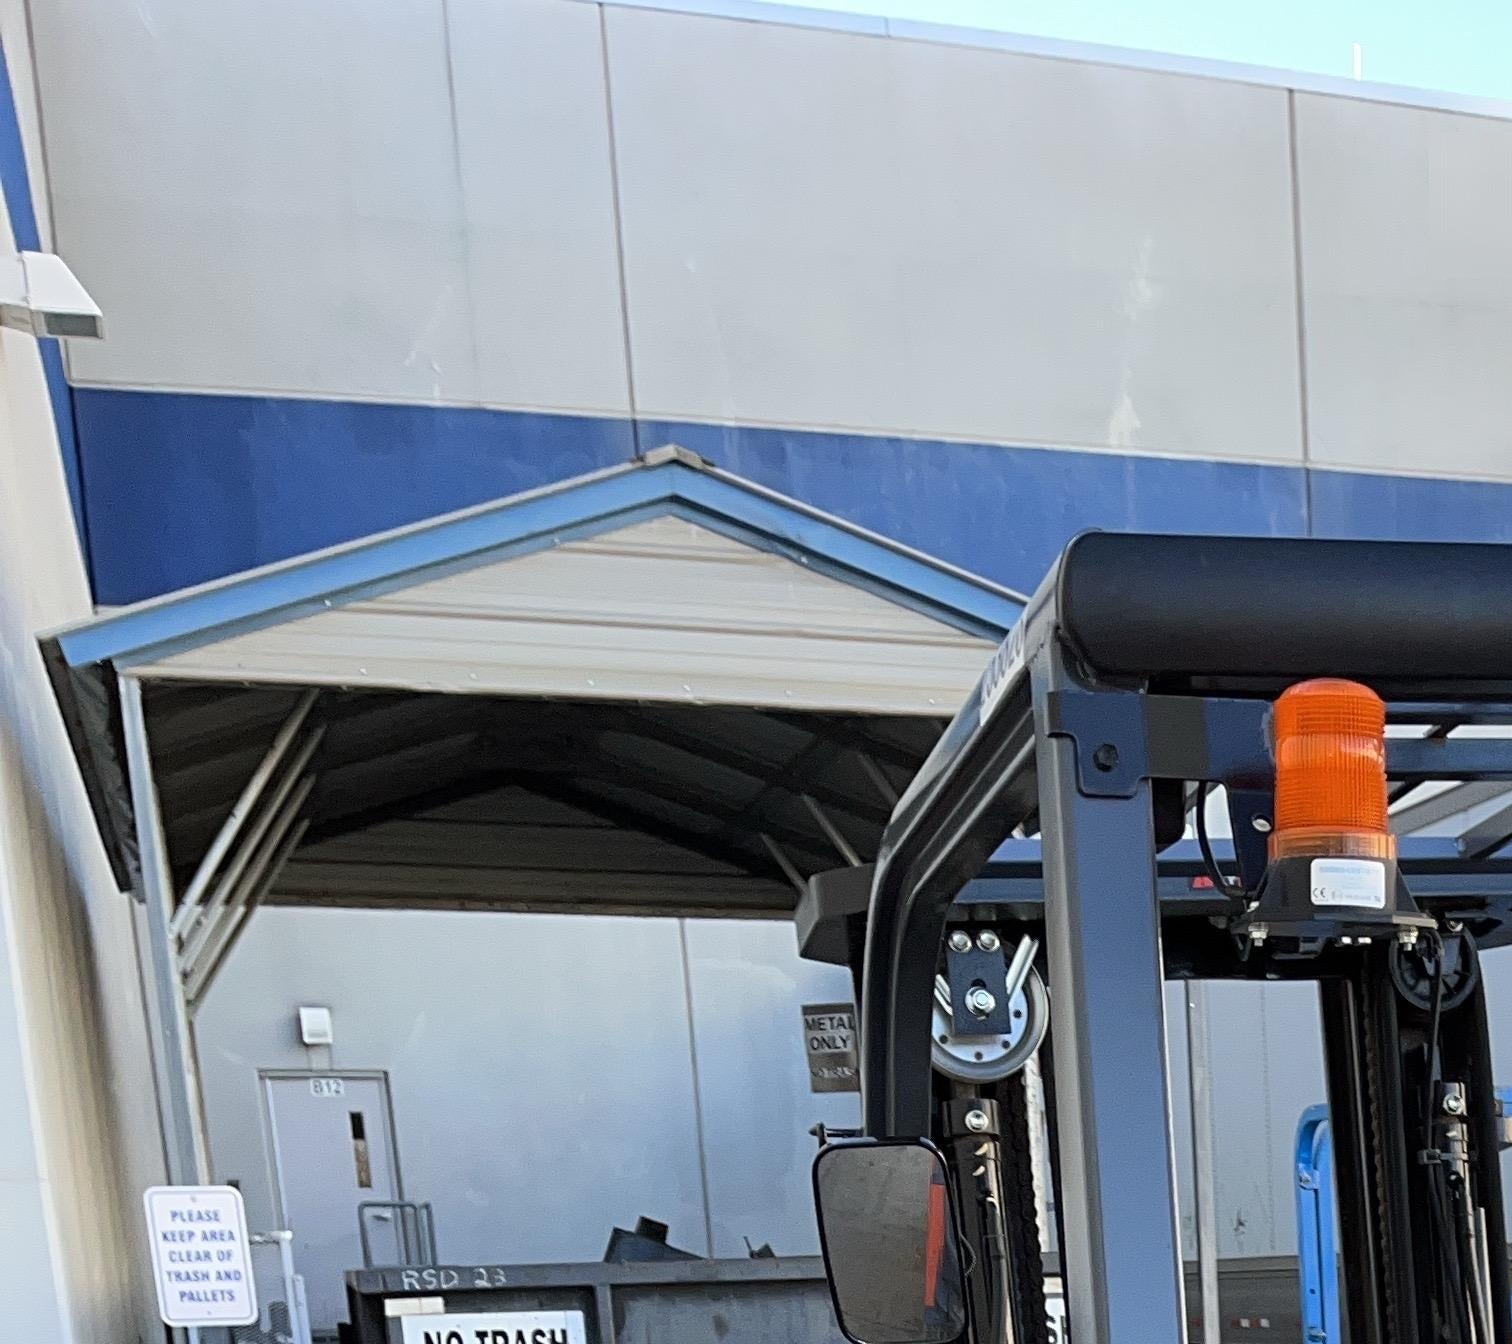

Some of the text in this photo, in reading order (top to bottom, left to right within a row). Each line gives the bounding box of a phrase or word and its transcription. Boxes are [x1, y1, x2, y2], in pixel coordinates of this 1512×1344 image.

[804, 1015, 858, 1031] METAL
[810, 1035, 849, 1050] ONLY
[169, 1210, 220, 1222] PLEASE
[161, 1230, 235, 1242] KEEP AREA
[168, 1249, 232, 1262] CLEAR OF
[166, 1270, 242, 1282] TRASH AND
[401, 1268, 508, 1290] RSD 23
[180, 1290, 235, 1302] PALLETS
